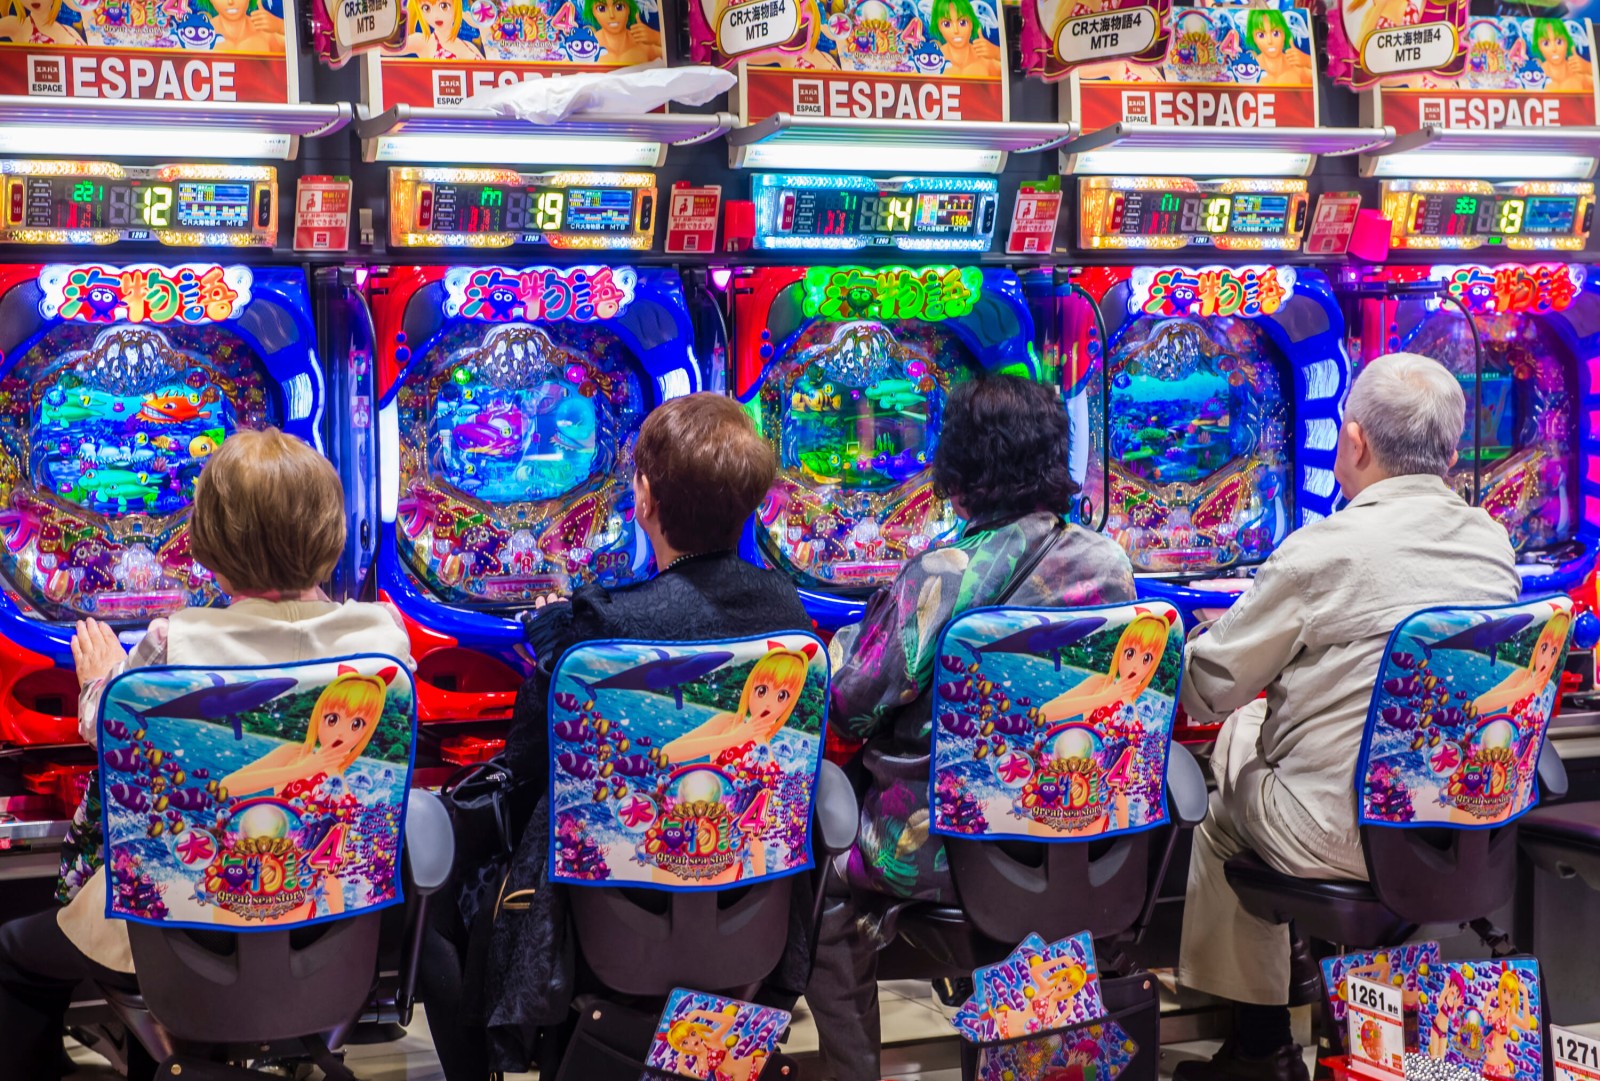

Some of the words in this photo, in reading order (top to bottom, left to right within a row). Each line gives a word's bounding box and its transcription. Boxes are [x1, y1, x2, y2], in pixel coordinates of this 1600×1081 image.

[357, 15, 375, 34] MTB
[730, 2, 785, 27] CR大海物語4
[1072, 16, 1142, 37] CR大海物語4
[745, 24, 769, 42] MTB
[1090, 33, 1119, 50] MTB
[1377, 28, 1441, 49] CR大海物語4
[1395, 47, 1421, 63] MTB
[32, 83, 63, 92] ESPACE
[72, 57, 236, 101] ESPACE
[796, 104, 822, 112] ESPACE
[829, 81, 962, 121] ESPACE
[1154, 91, 1276, 127] ESPACE
[1449, 98, 1560, 129] ESPACE
[1126, 115, 1148, 123] ESPACE
[73, 184, 104, 202] 221
[144, 187, 172, 226] 12
[537, 192, 564, 230] 19
[886, 197, 913, 231] 14
[1206, 198, 1231, 232] 10
[226, 219, 244, 227] MTB
[951, 215, 968, 226] 1360
[59, 267, 237, 322] 海物語
[461, 268, 625, 321] 海物語
[1144, 267, 1286, 316] 海物語
[1106, 746, 1137, 791] 4
[738, 788, 773, 836] 4
[1032, 805, 1061, 817] great
[1063, 809, 1079, 817] sea
[1081, 805, 1102, 816] story
[309, 823, 347, 874] 4
[656, 852, 687, 865] great
[689, 857, 708, 865] sea
[710, 851, 735, 864] story
[217, 890, 251, 904] great
[252, 895, 273, 904] sea
[275, 889, 306, 902] story
[1351, 983, 1384, 1011] 1261
[1557, 1035, 1598, 1068] 1271
